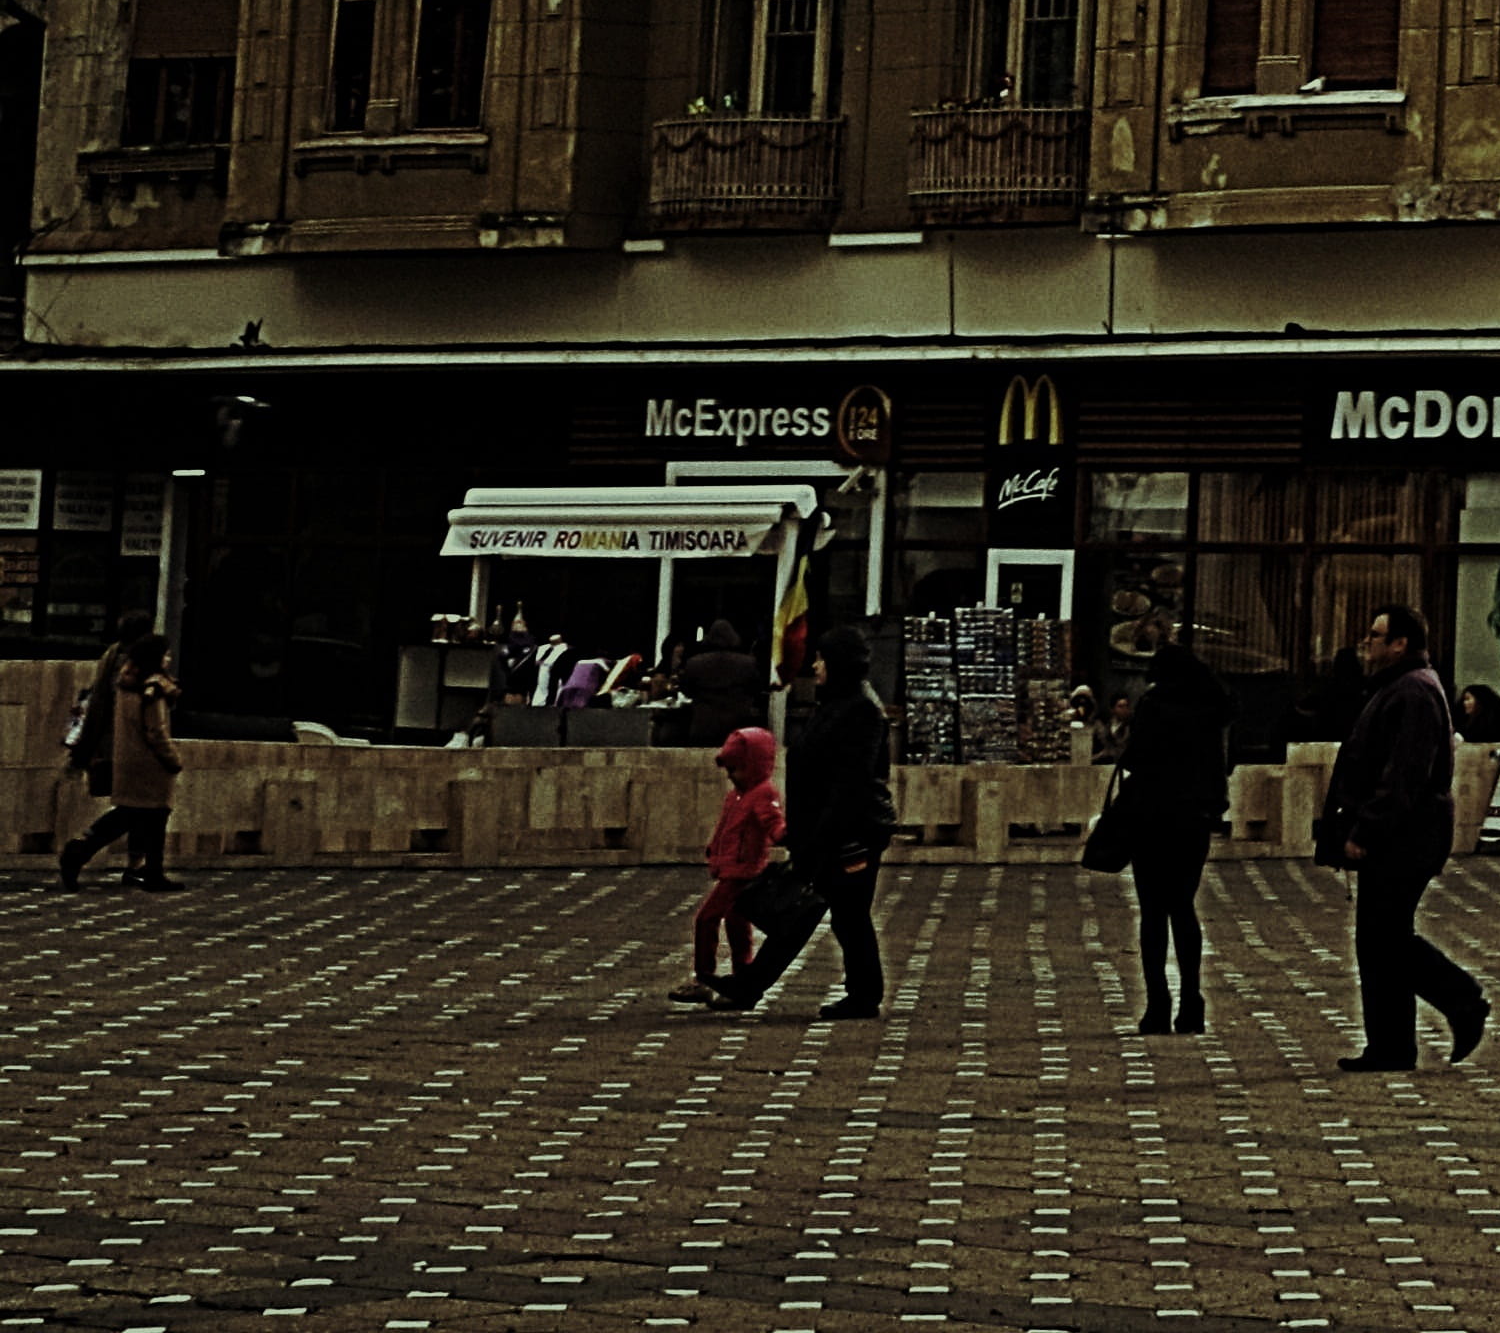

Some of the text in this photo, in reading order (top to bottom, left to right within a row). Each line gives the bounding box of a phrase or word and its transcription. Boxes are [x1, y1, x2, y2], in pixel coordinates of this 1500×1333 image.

[645, 398, 831, 446] McExpress
[470, 530, 749, 550] SUVENIR ROMANIA TIMISOARA
